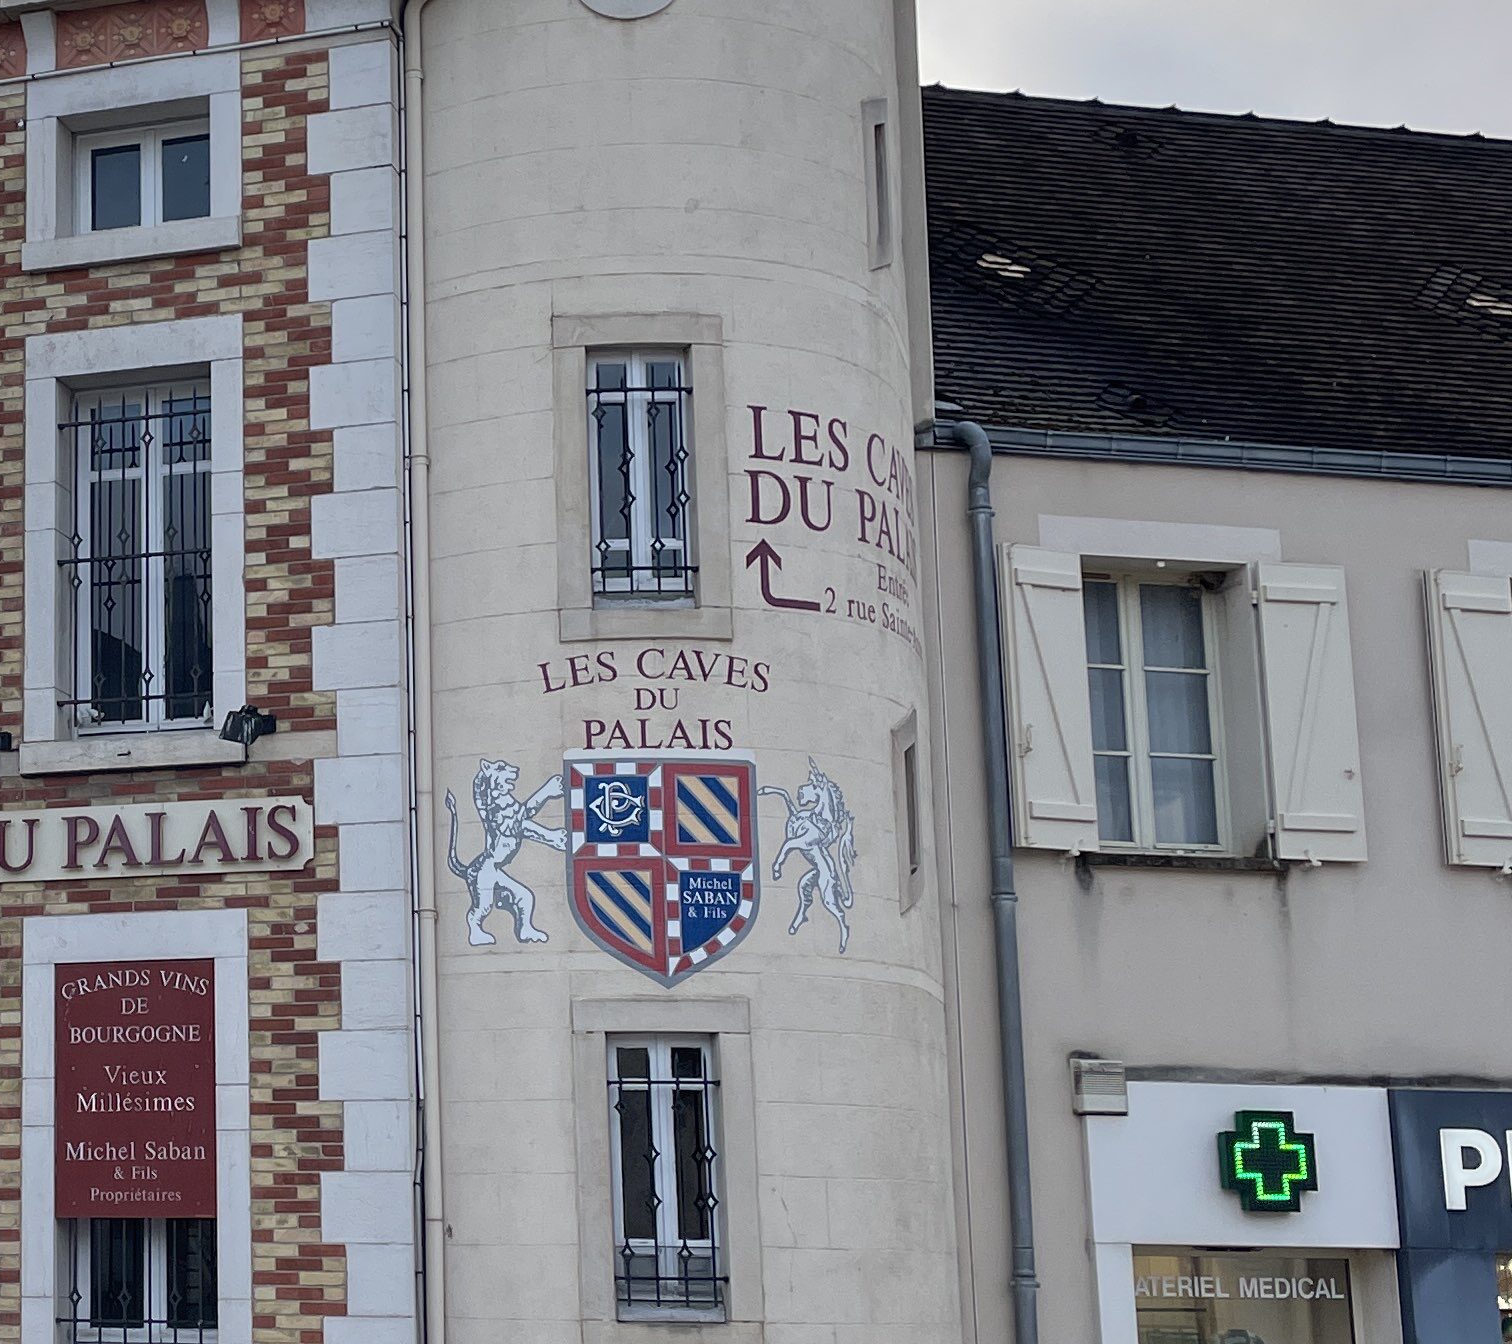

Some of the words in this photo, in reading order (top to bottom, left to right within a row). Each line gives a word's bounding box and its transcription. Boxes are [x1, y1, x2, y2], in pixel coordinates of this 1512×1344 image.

[746, 404, 850, 472] LES
[744, 469, 834, 532] DU
[824, 587, 837, 614] 2
[846, 599, 876, 624] rue
[537, 651, 619, 694] LES
[636, 648, 771, 693] CAVES
[634, 687, 680, 711] DU
[582, 718, 734, 751] PALAIS
[61, 804, 300, 869] PALAIS
[689, 877, 732, 890] Michel
[683, 890, 738, 905] SABAN
[688, 906, 697, 918] &
[704, 906, 727, 918] Fils
[61, 969, 151, 1000] GRANDS
[160, 970, 210, 996] VINS
[120, 997, 150, 1015] DE
[69, 1025, 201, 1044] BOURGOGNE
[104, 1065, 167, 1085] Vieux
[76, 1091, 195, 1113] Millésimes
[65, 1141, 136, 1161] Michel
[145, 1141, 206, 1160] Saban
[113, 1166, 125, 1180] &
[131, 1166, 158, 1180] Fils
[1439, 1128, 1512, 1211] P
[90, 1187, 182, 1205] Propriétaires
[1239, 1277, 1345, 1300] MEDICAL
